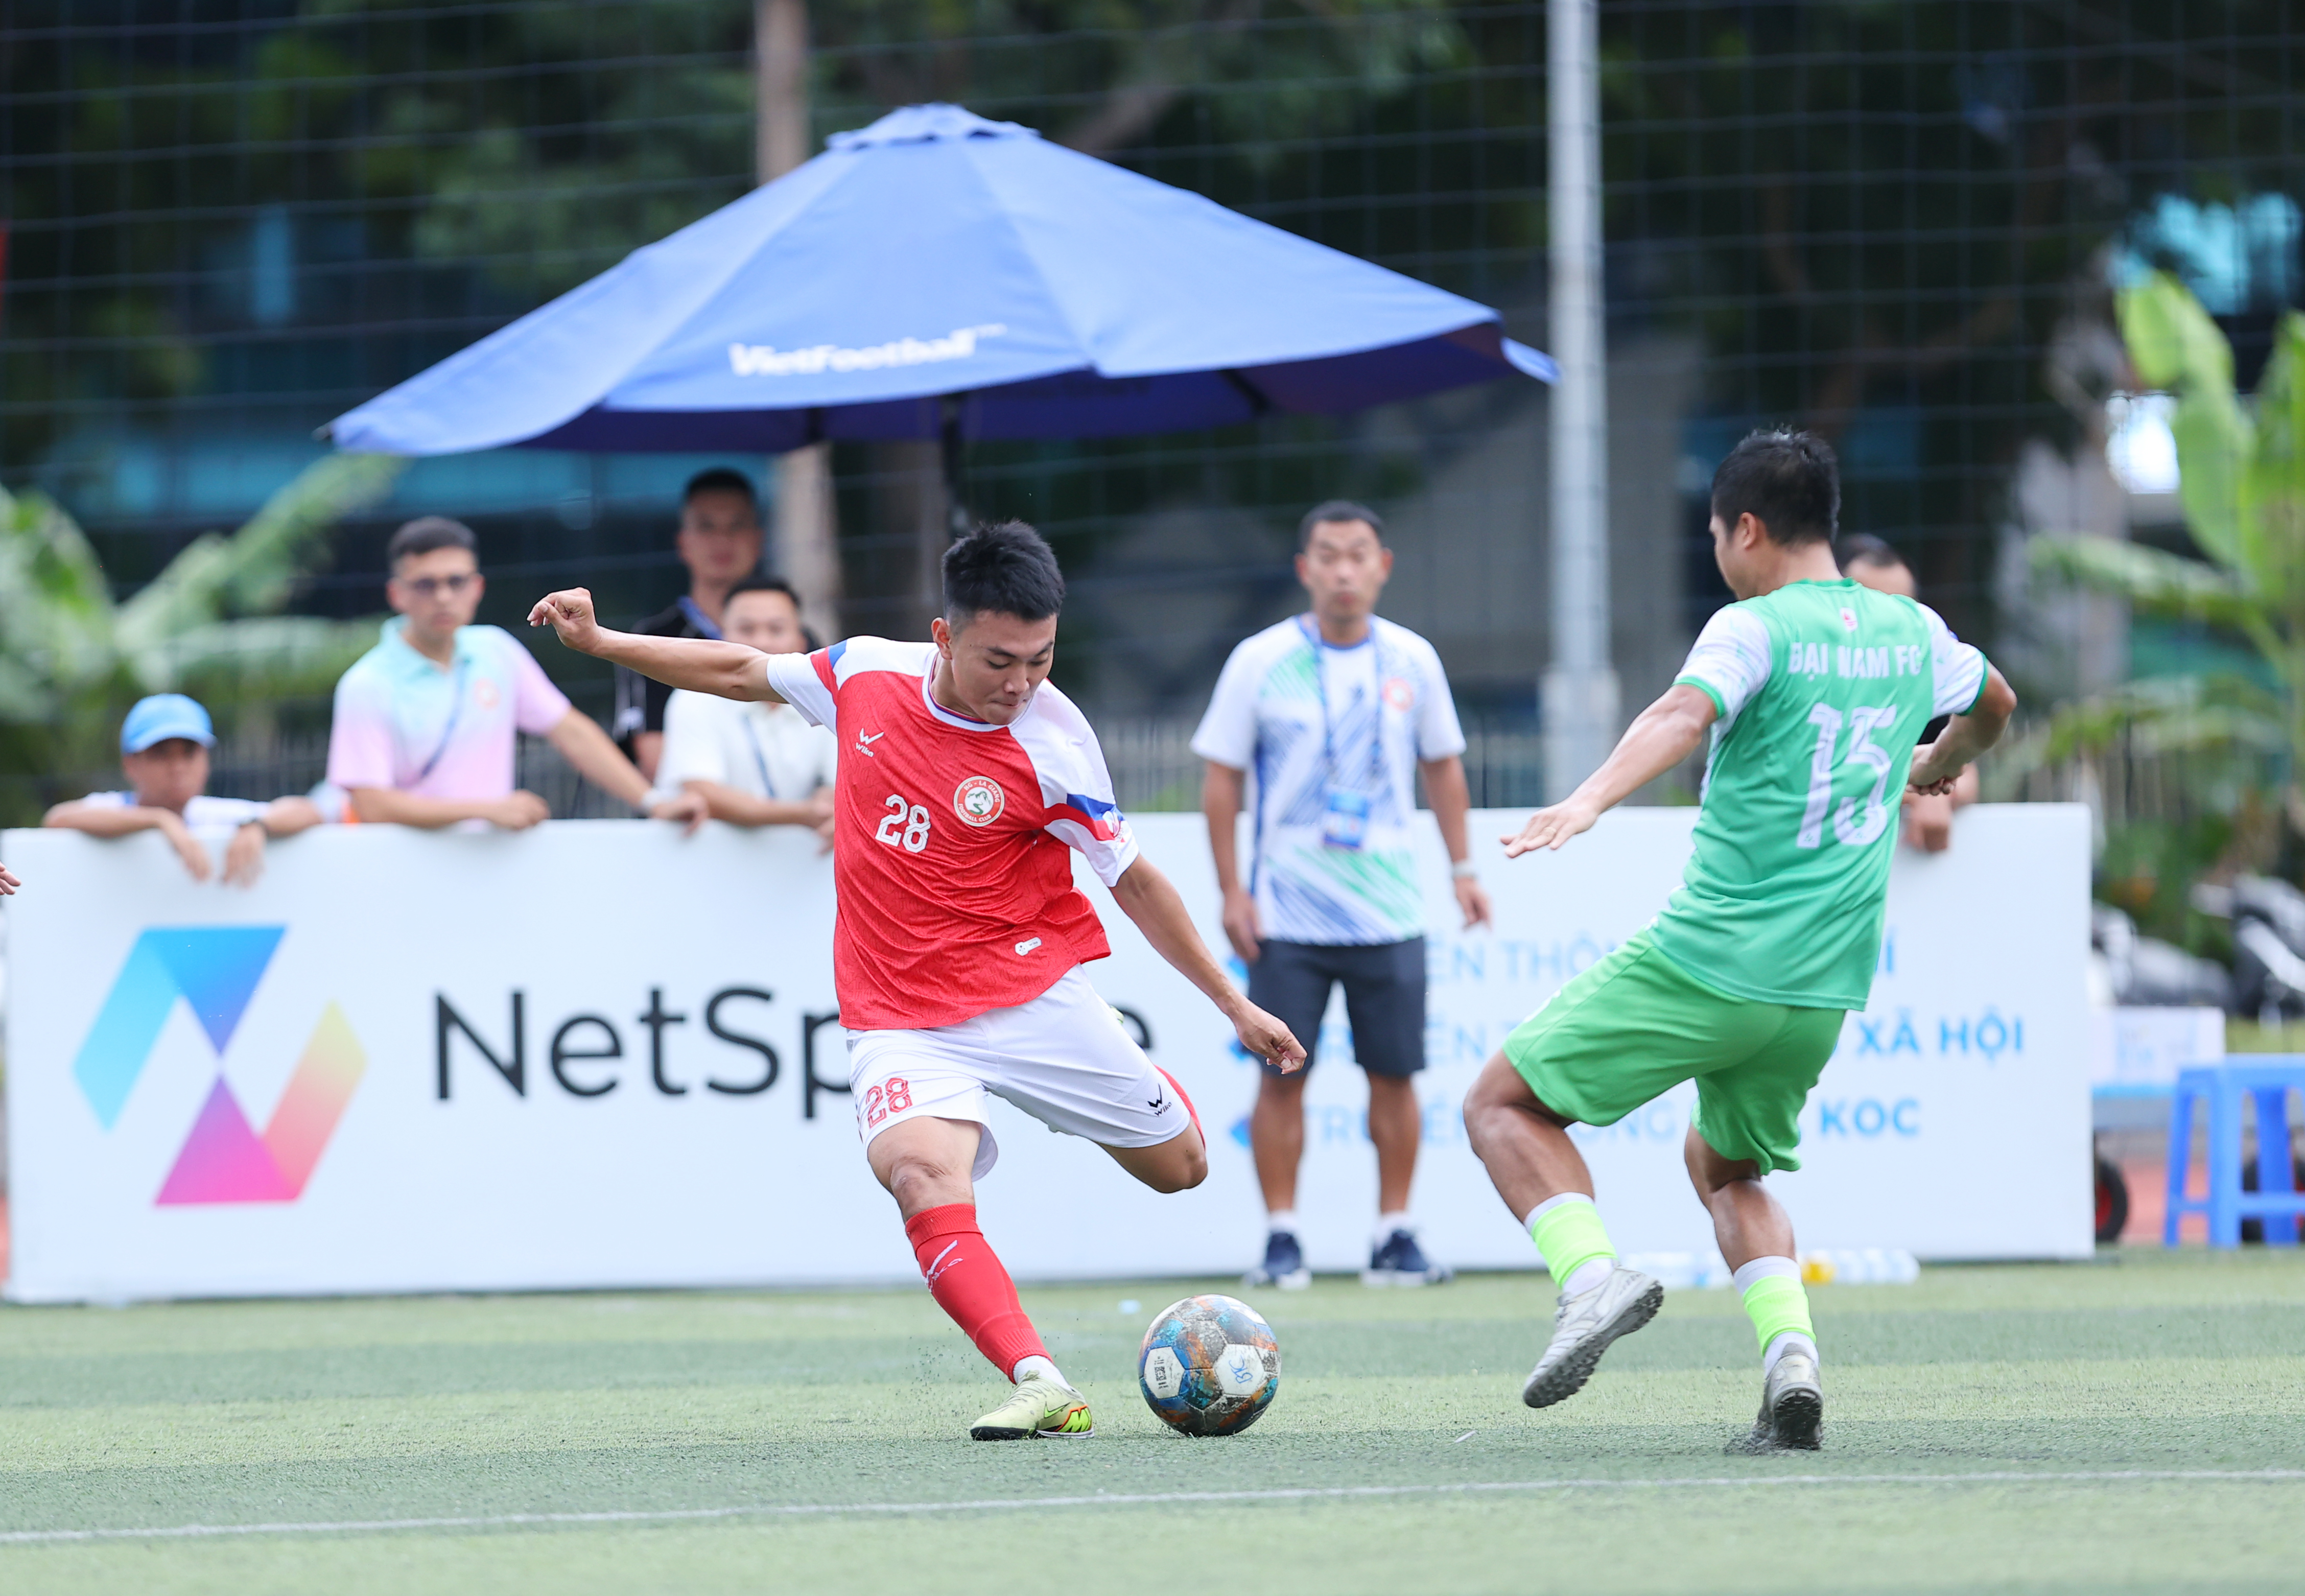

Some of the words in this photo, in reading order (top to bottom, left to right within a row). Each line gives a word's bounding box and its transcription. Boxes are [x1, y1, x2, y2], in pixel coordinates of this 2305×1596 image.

[1837, 645, 1890, 678] NAM
[1894, 644, 1923, 677] FC
[988, 784, 1000, 803] GIANG
[1796, 702, 1897, 849] 15
[875, 793, 931, 854] 28
[958, 803, 978, 822] FOOTBALL
[978, 814, 992, 822] CLUB
[1940, 1004, 2024, 1065] HỘI
[865, 1077, 913, 1129] 28
[1820, 1098, 1921, 1136] KOC
